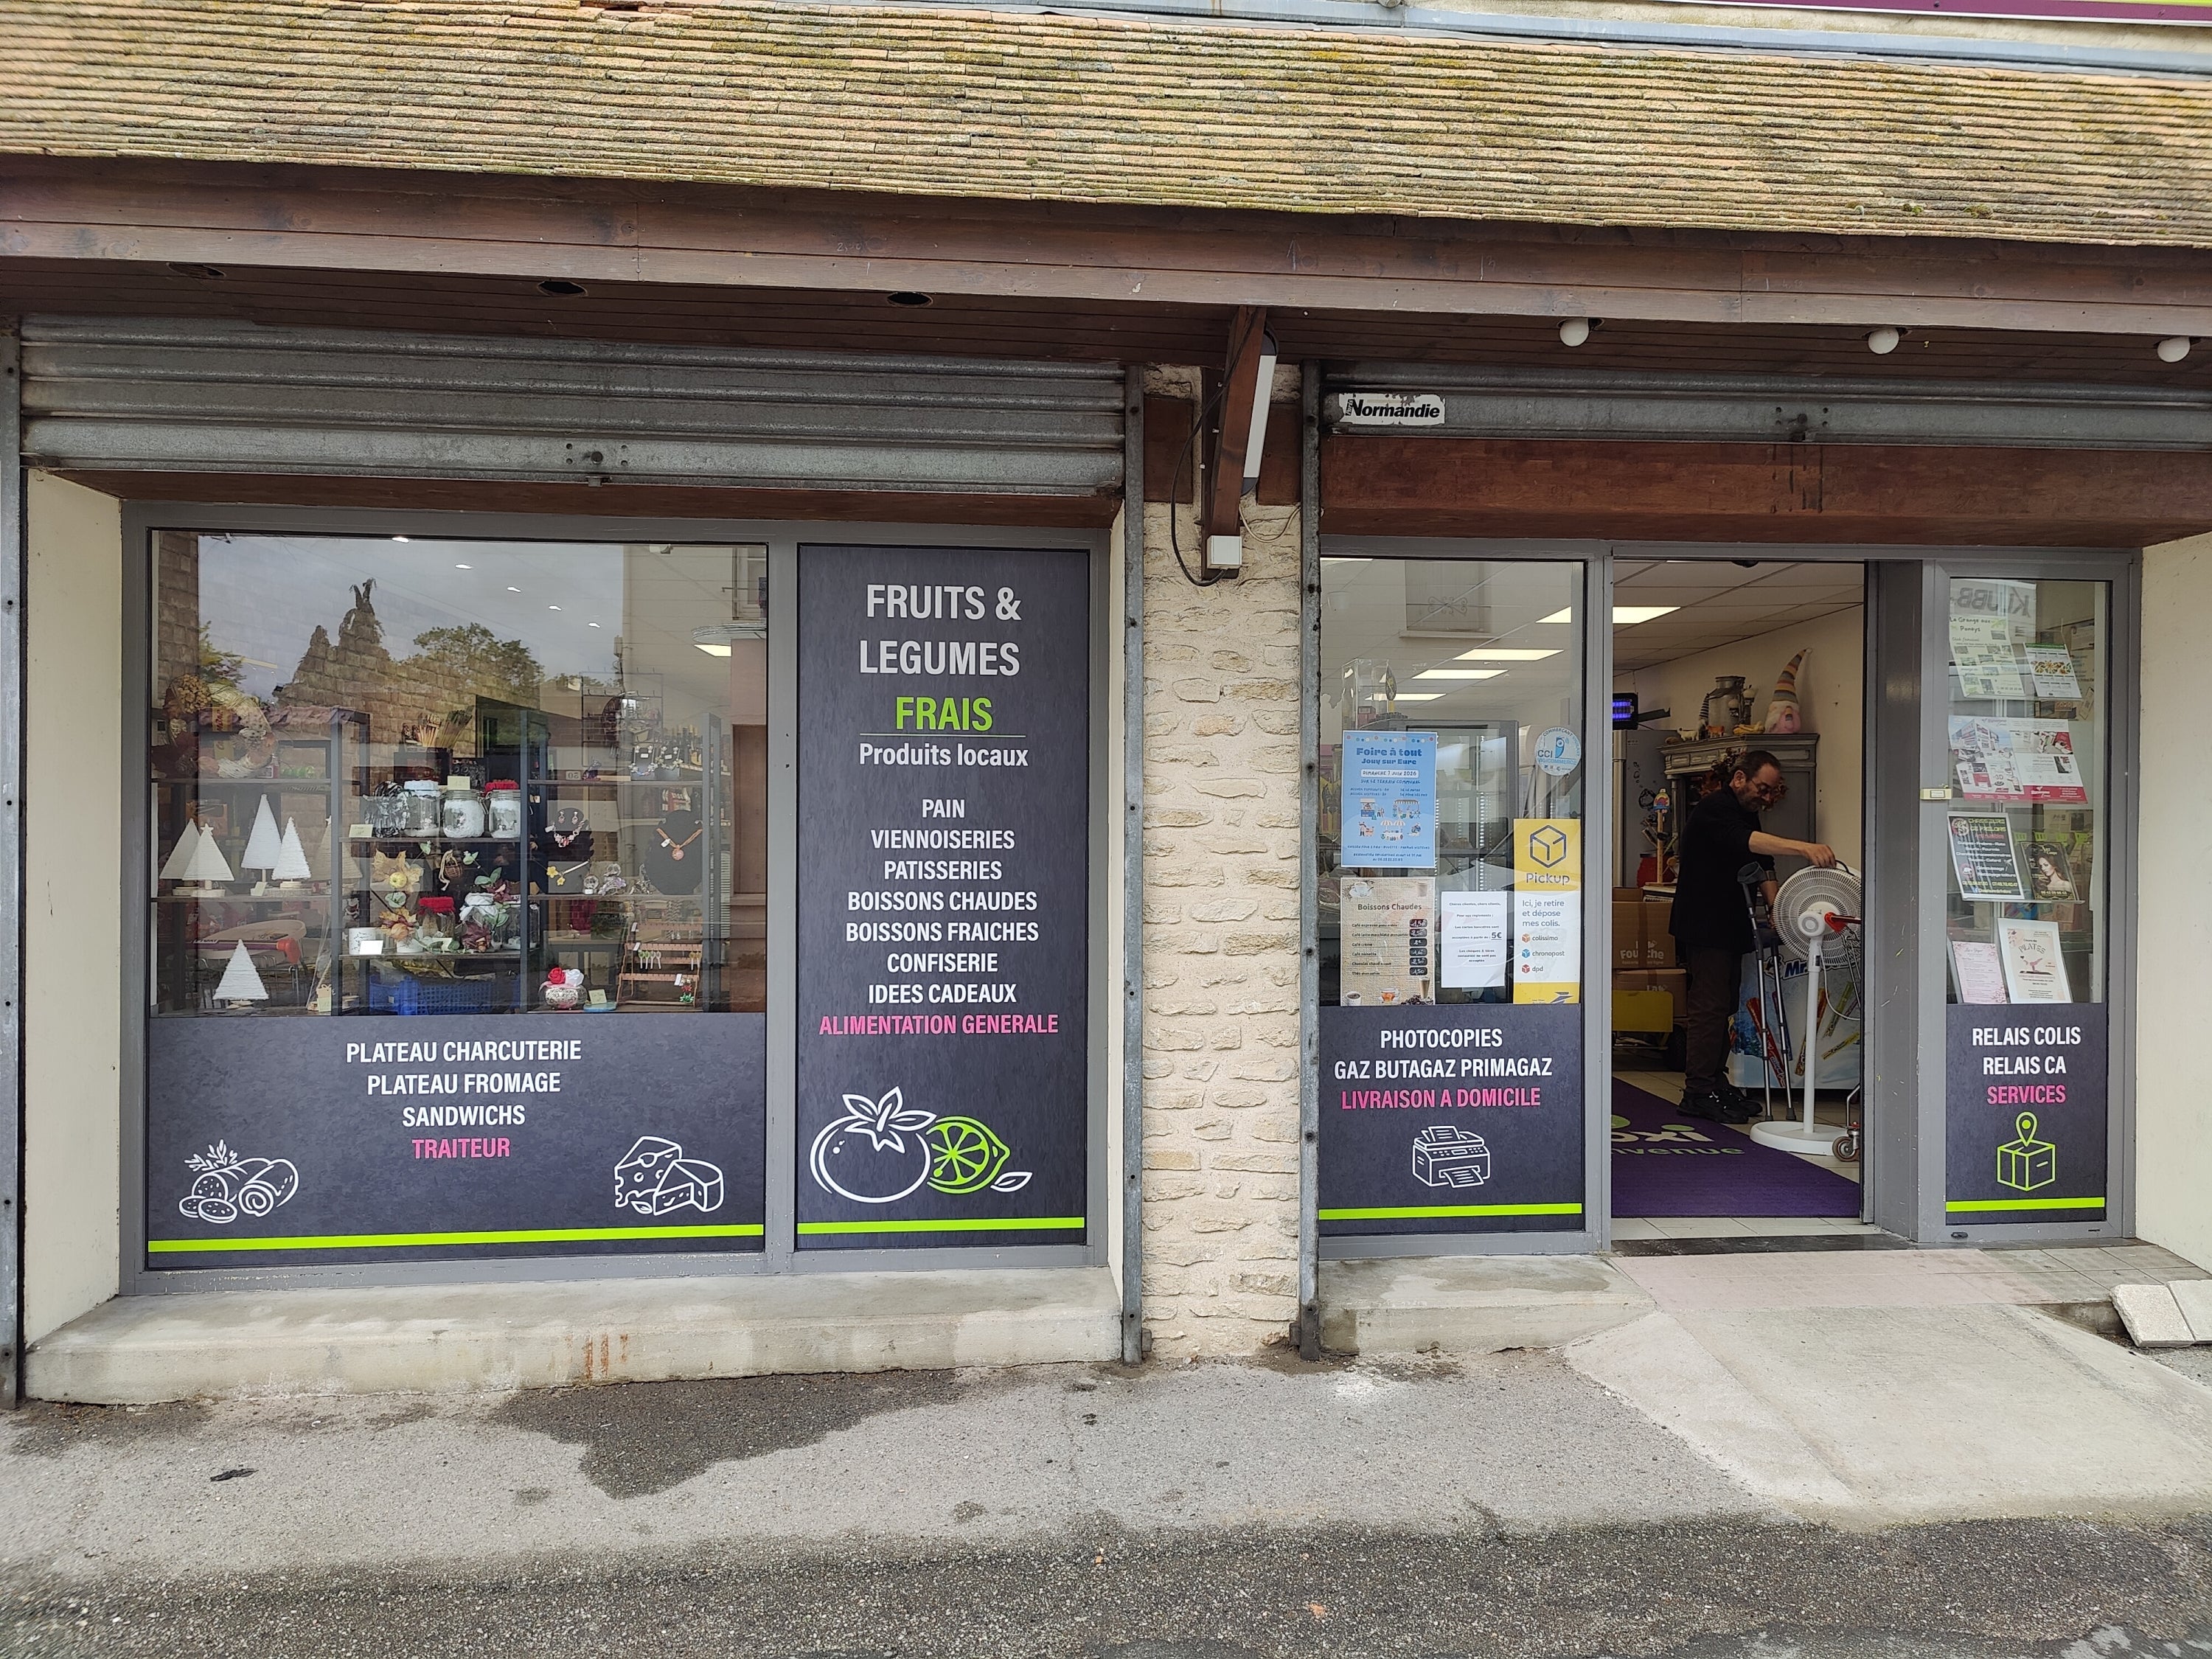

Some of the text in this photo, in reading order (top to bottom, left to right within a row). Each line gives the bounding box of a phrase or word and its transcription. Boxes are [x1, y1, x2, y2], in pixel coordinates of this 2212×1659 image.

[1352, 399, 1440, 418] Normandie
[866, 584, 1022, 621] FRUITS &
[859, 640, 1020, 676] LEGUMES
[895, 697, 993, 731] FRAIS
[859, 742, 1029, 767] Produits locaux
[1356, 748, 1388, 756] Foire
[1399, 748, 1422, 757] tout
[1537, 750, 1553, 758] CCI
[922, 799, 965, 818] PAIN
[870, 830, 1015, 849] VIENNOISERIES
[884, 860, 1002, 880] PATISSERIES
[1526, 873, 1570, 886] Pickup
[848, 891, 1037, 911] BOISSONS CHAUDES
[1522, 900, 1533, 908] Ici,
[1534, 900, 1542, 908] je
[1532, 909, 1561, 918] dépose
[846, 922, 1039, 942] BOISSONS FRAICHES
[887, 953, 998, 973] CONFISERIE
[1784, 960, 1807, 978] Mr.
[869, 984, 1017, 1004] IDEES CADEAUX
[818, 1014, 1059, 1035] ALIMENTATION GENERALE
[1380, 1029, 1503, 1048] PHOTOCOPIES
[1972, 1026, 2081, 1046] RELAIS COLIS
[346, 1040, 582, 1063] PLATEAU CHARCUTERIE
[1334, 1057, 1553, 1079] GAZ BUTAGAZ PRIMAGAZ
[1983, 1056, 2067, 1075] RELAIS CA
[367, 1072, 561, 1096] PLATEAU FROMAGE
[1340, 1087, 1541, 1110] LIVRAISON A DOMICILE
[1987, 1085, 2066, 1105] SERVICES
[402, 1105, 526, 1127] SANDWICHS
[411, 1137, 511, 1159] TRAITEUR
